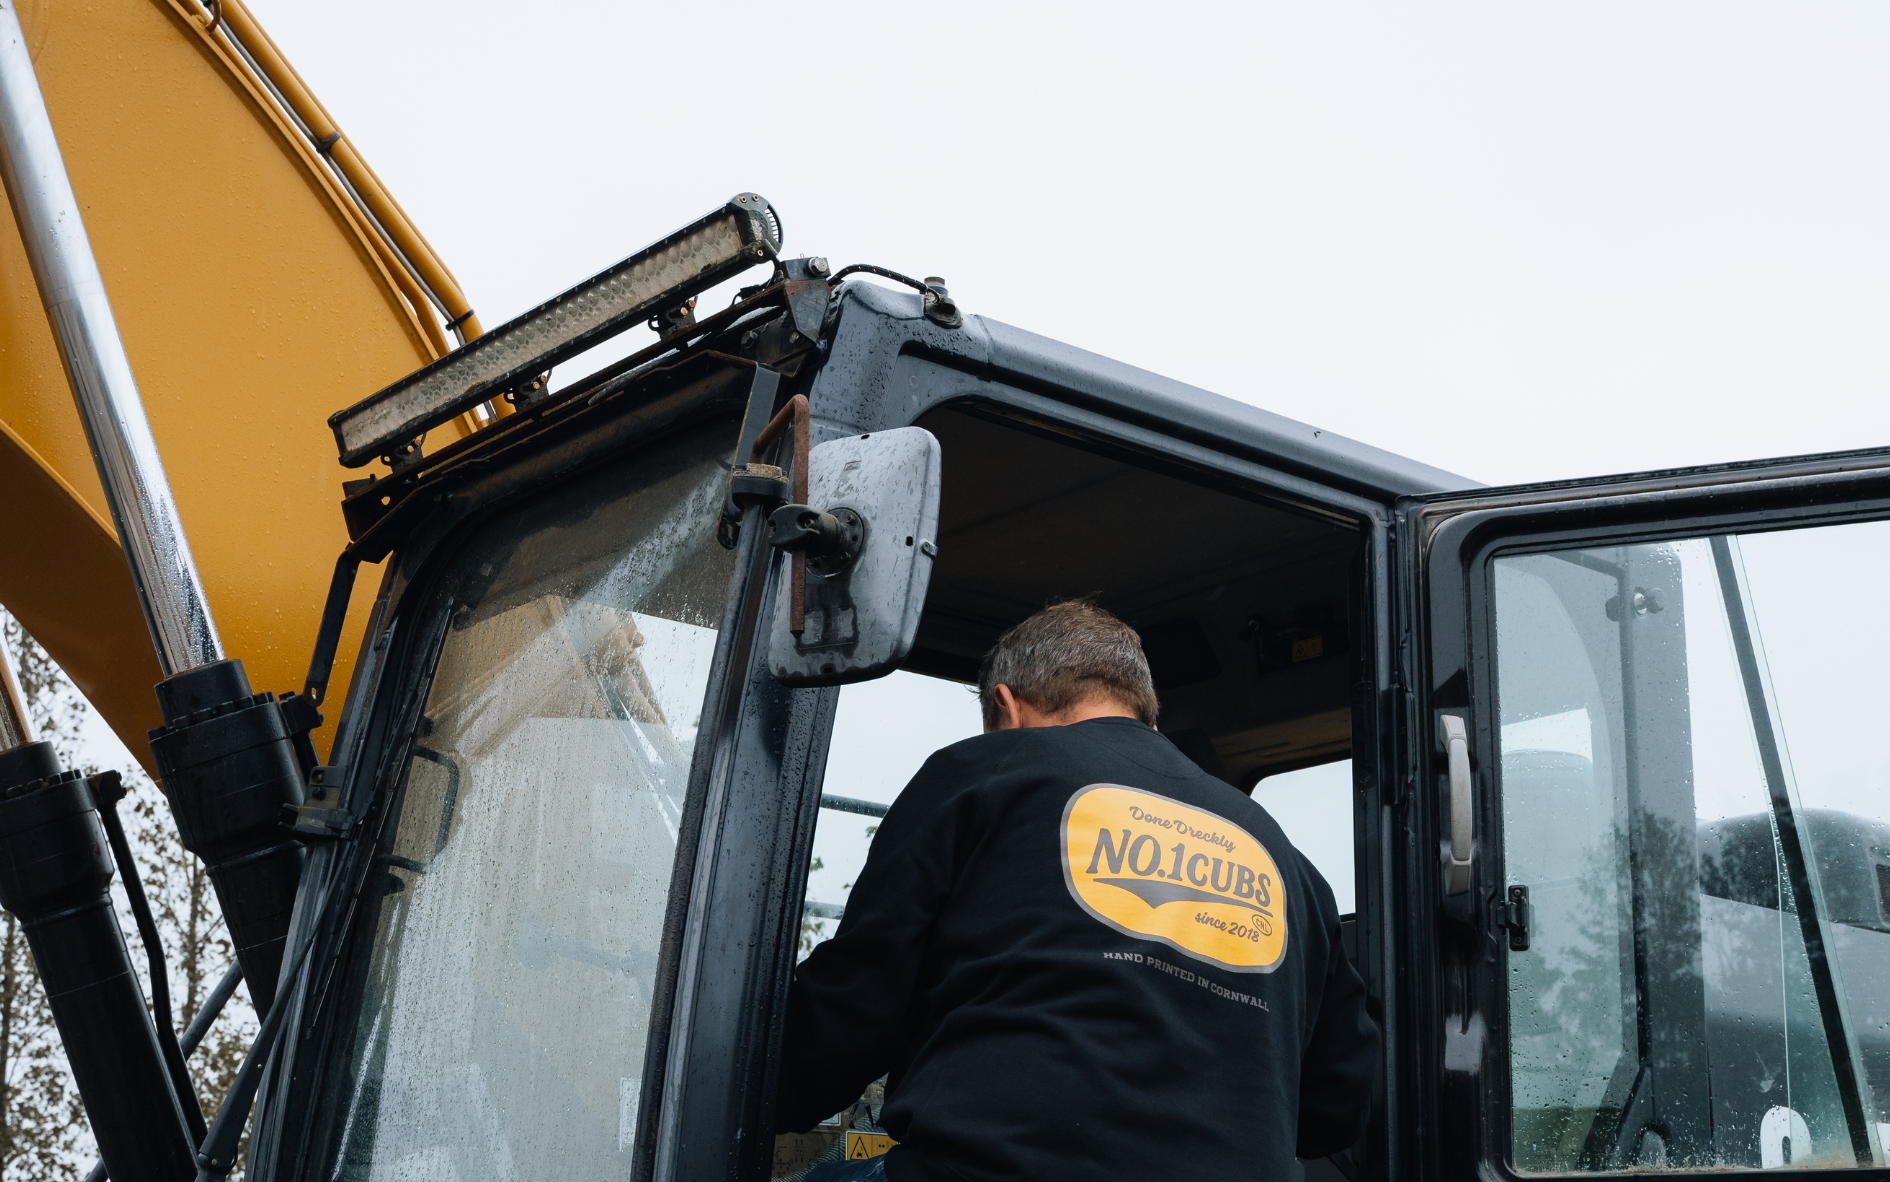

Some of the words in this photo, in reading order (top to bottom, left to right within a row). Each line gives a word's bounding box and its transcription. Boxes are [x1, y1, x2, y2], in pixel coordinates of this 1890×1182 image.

[1129, 806, 1173, 829] Done
[1173, 820, 1236, 853] Dreckly
[1195, 912, 1227, 931] since
[1228, 922, 1259, 942] 2018
[1103, 952, 1144, 963] HAND
[1147, 957, 1196, 983] PRINTED
[1197, 976, 1210, 989] IN
[1210, 983, 1270, 1012] CORNWALL
